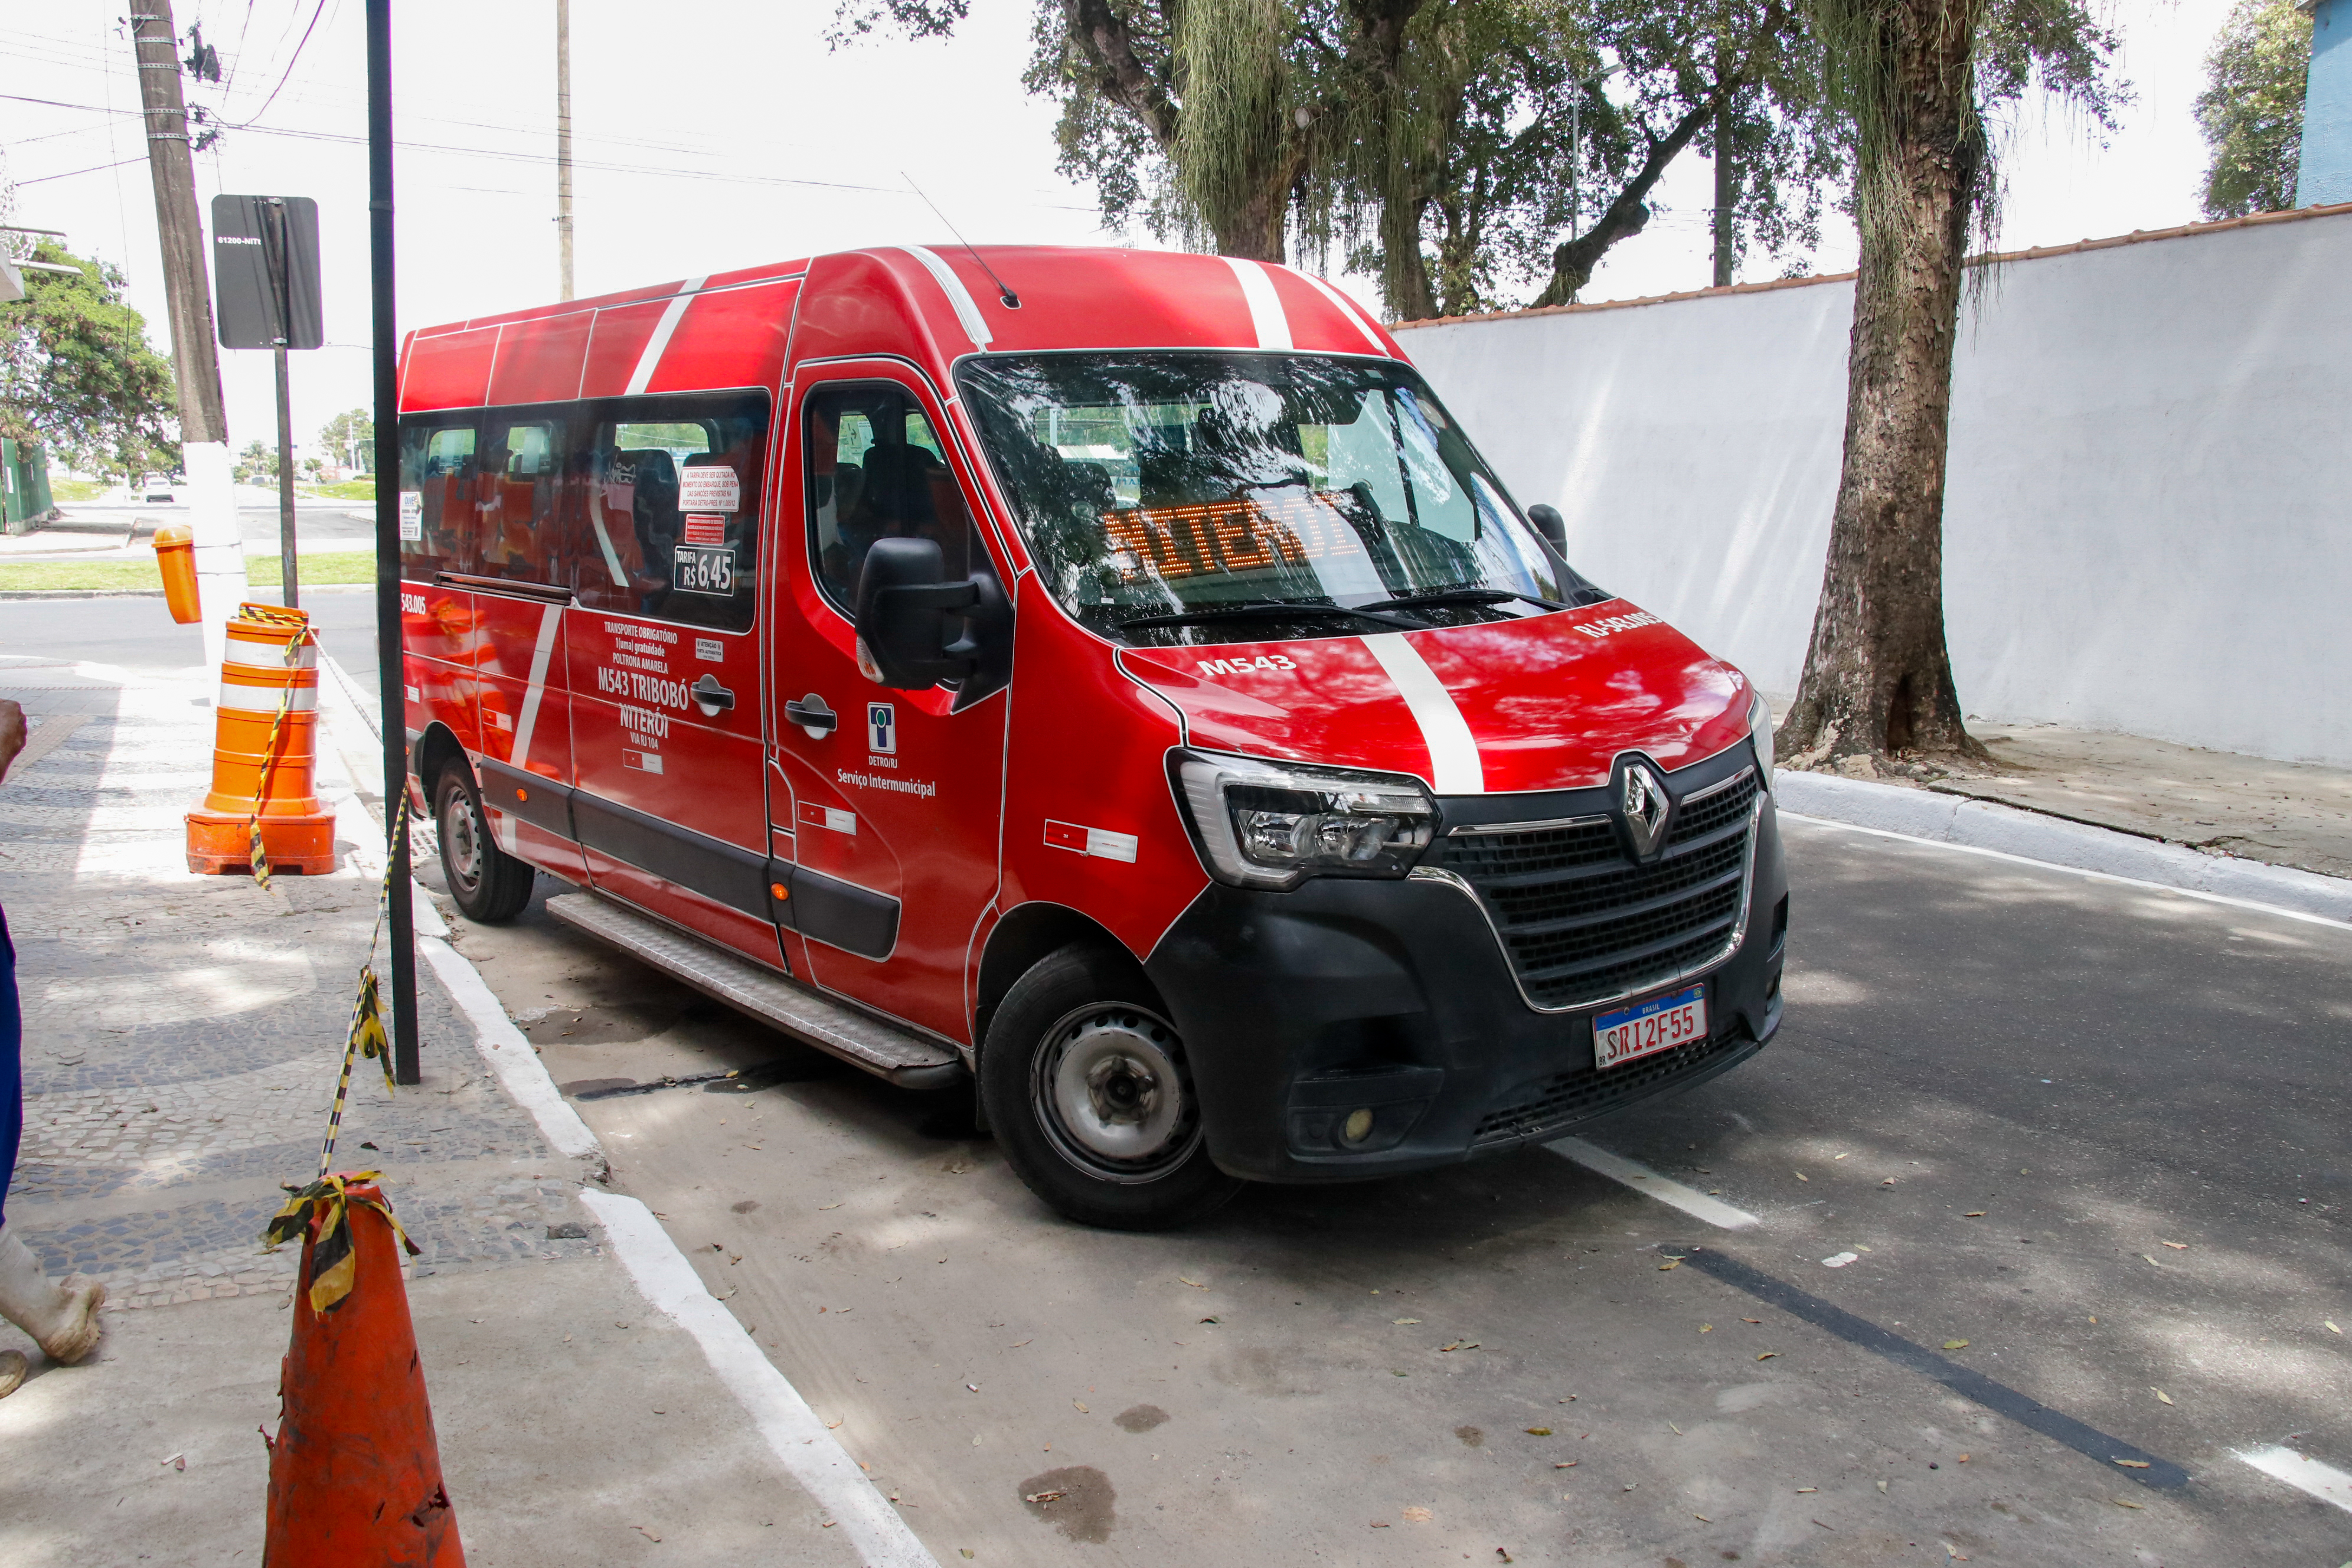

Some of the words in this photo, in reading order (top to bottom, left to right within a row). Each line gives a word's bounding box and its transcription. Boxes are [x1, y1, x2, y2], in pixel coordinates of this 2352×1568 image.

[677, 550, 696, 564] TARIFA
[684, 565, 696, 589] R$
[698, 554, 731, 590] 6,45
[604, 621, 638, 638] TRANSPORTE
[639, 628, 678, 645] OBRIGATÓRIO
[1572, 612, 1664, 638] RJ-543.005
[615, 637, 633, 652] 1(uma)
[634, 642, 665, 657] gratuidade
[613, 652, 641, 669] POLTRONA
[641, 658, 668, 674] AMARELA
[1196, 655, 1297, 676] M543
[598, 666, 629, 696] M543
[631, 672, 688, 711] TRIBOBÓ
[619, 702, 668, 739] NITERÓI
[630, 731, 640, 745] VIA
[641, 733, 647, 747] RJ
[648, 736, 659, 750] 104
[868, 755, 898, 769] DETRO/RJ
[837, 768, 868, 789] Serviço
[869, 773, 936, 799] Intermunicipal
[1642, 1004, 1660, 1014] BRASIL
[1607, 1005, 1694, 1060] SRI2F55
[1599, 1056, 1606, 1066] BR
